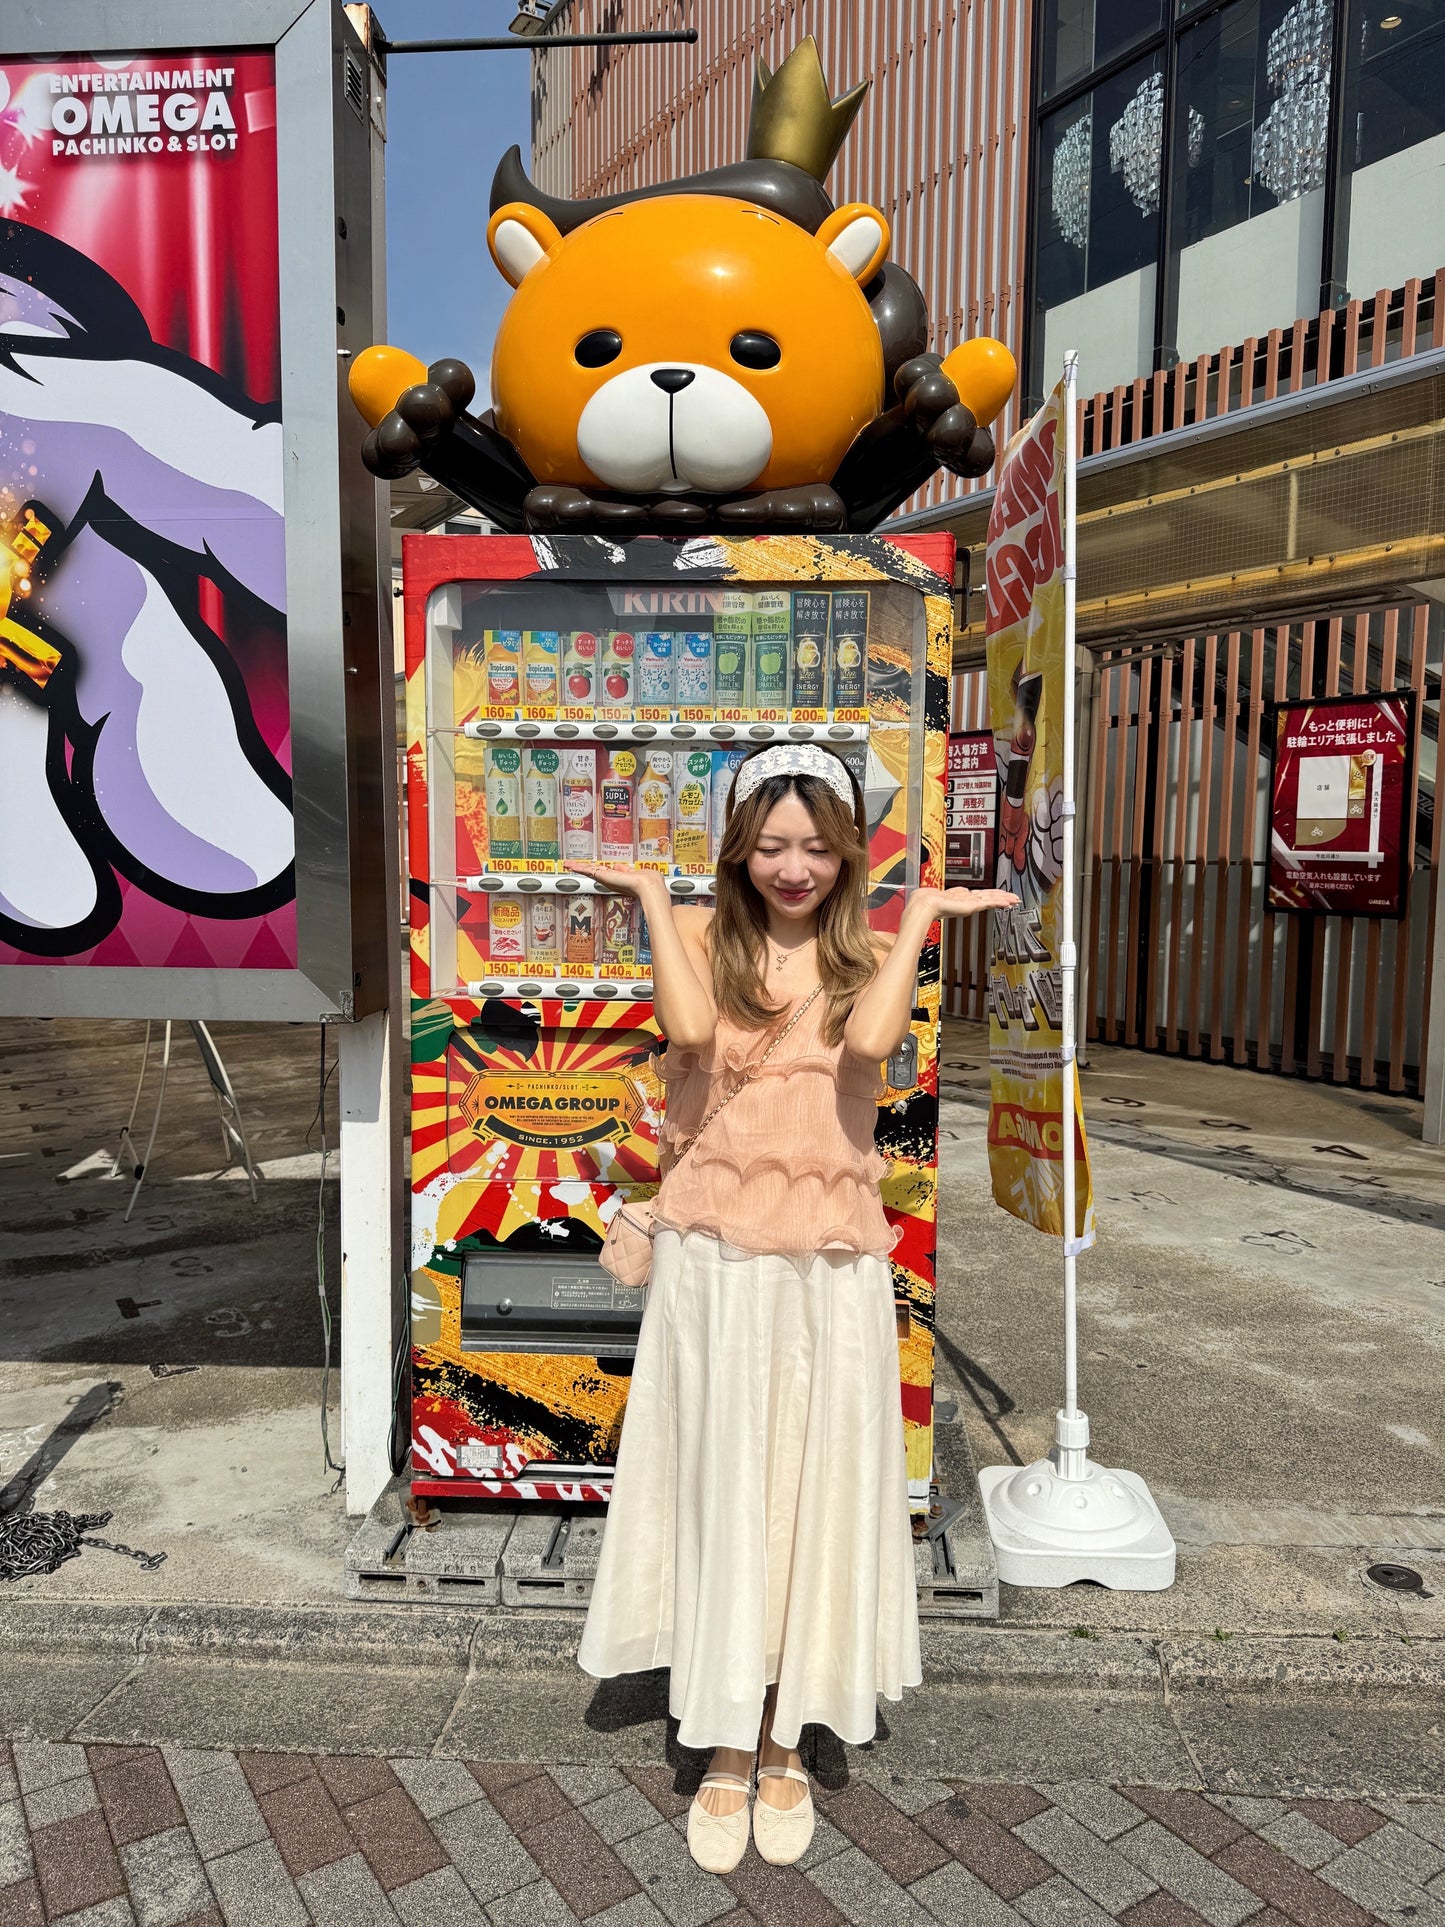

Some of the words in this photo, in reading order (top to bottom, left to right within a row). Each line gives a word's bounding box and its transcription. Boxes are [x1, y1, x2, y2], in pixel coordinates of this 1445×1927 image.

[50, 69, 235, 93] ENTERTAINMENT
[51, 92, 236, 136] OMEGA
[52, 135, 164, 156] PACHINKO
[187, 134, 238, 151] SLOT
[624, 592, 724, 613] KIRIN
[796, 599, 827, 608] 冒険心を
[835, 599, 865, 608] 冒険心を
[490, 663, 515, 673] Tropicana
[528, 664, 553, 673] Tropicana
[1308, 718, 1373, 732] もっと便利に!
[1286, 731, 1396, 748] 駐輪エリア拡張しました
[688, 756, 711, 766] スッキリ
[681, 791, 700, 799] レモン
[958, 815, 988, 826] 入場開始
[1285, 871, 1382, 882] 電動空気入れも設置しています
[1309, 882, 1355, 890] 是非ご利用ください
[493, 906, 520, 917] 新商品
[570, 915, 591, 935] M
[485, 1096, 553, 1111] OMEGA
[555, 1097, 620, 1111] GROUP
